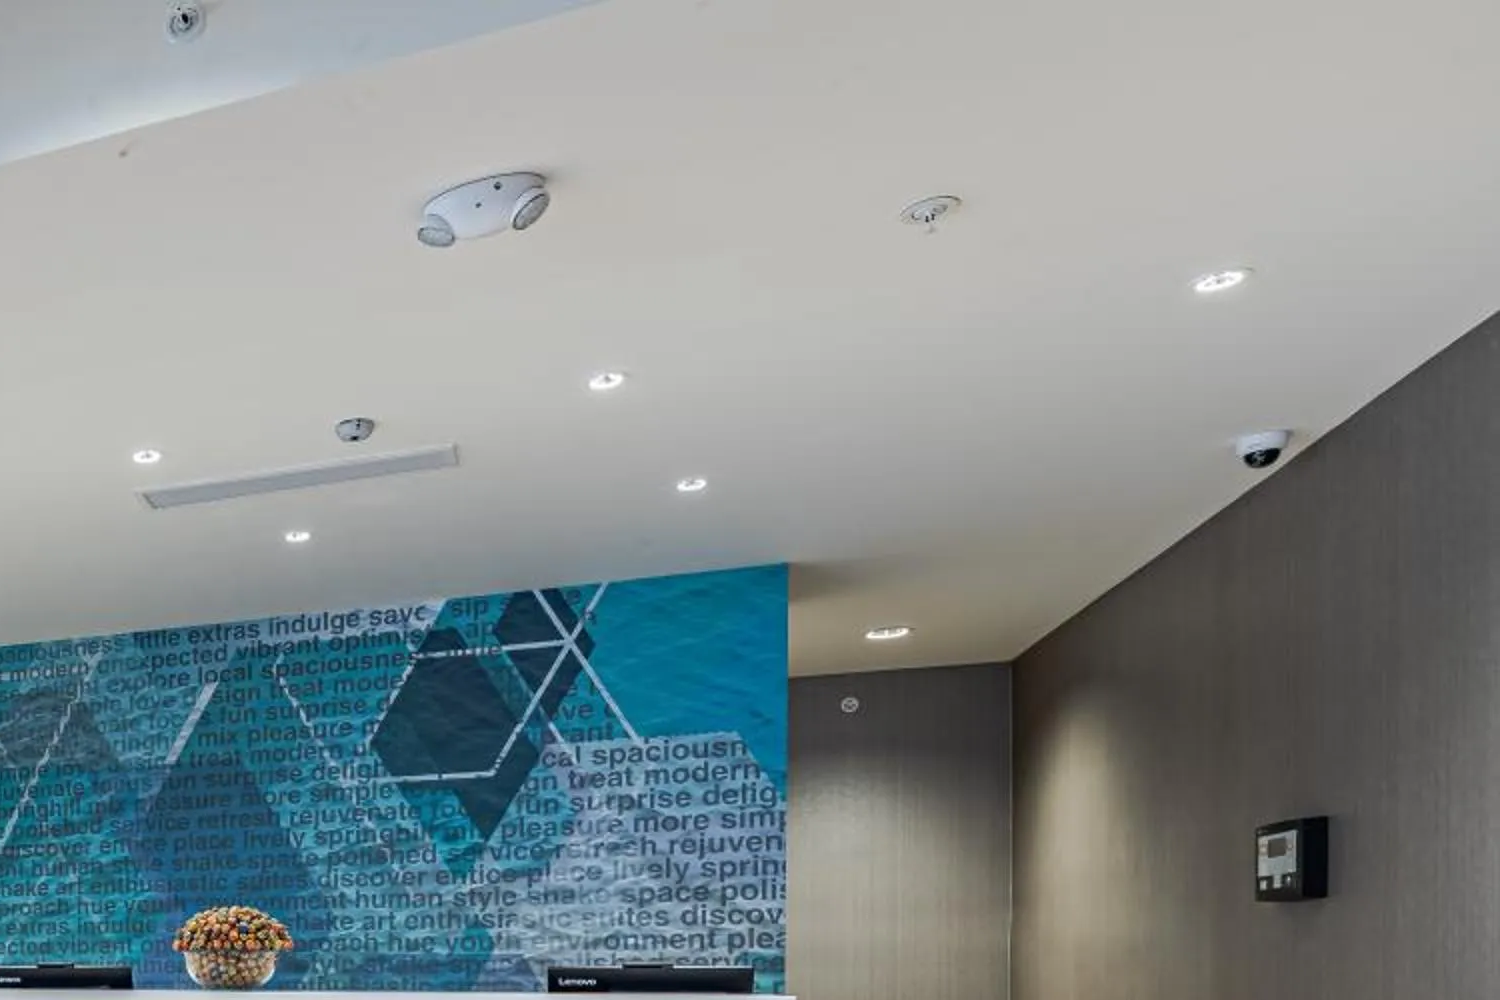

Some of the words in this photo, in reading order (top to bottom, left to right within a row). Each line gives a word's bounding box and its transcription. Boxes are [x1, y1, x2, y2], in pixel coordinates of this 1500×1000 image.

[187, 622, 261, 644] extras
[269, 610, 360, 636] indulge
[235, 635, 320, 659] vibrant
[198, 664, 252, 684] local
[271, 676, 324, 699] treat
[220, 705, 256, 724] fun
[198, 727, 238, 745] mix
[568, 766, 633, 789] treat
[644, 760, 761, 785] modern
[569, 787, 693, 816] surprise
[174, 833, 235, 854] place
[244, 827, 305, 849] lively
[501, 815, 624, 842] pleasure
[632, 811, 710, 833] more
[318, 866, 428, 890] discover
[436, 863, 518, 885] entice
[612, 857, 690, 885] lively
[78, 896, 117, 915] hue
[355, 889, 443, 909] human
[452, 885, 518, 912] style
[619, 880, 710, 908] space
[363, 910, 398, 930] art
[388, 930, 437, 952] hue
[558, 977, 598, 987] Lenovo
